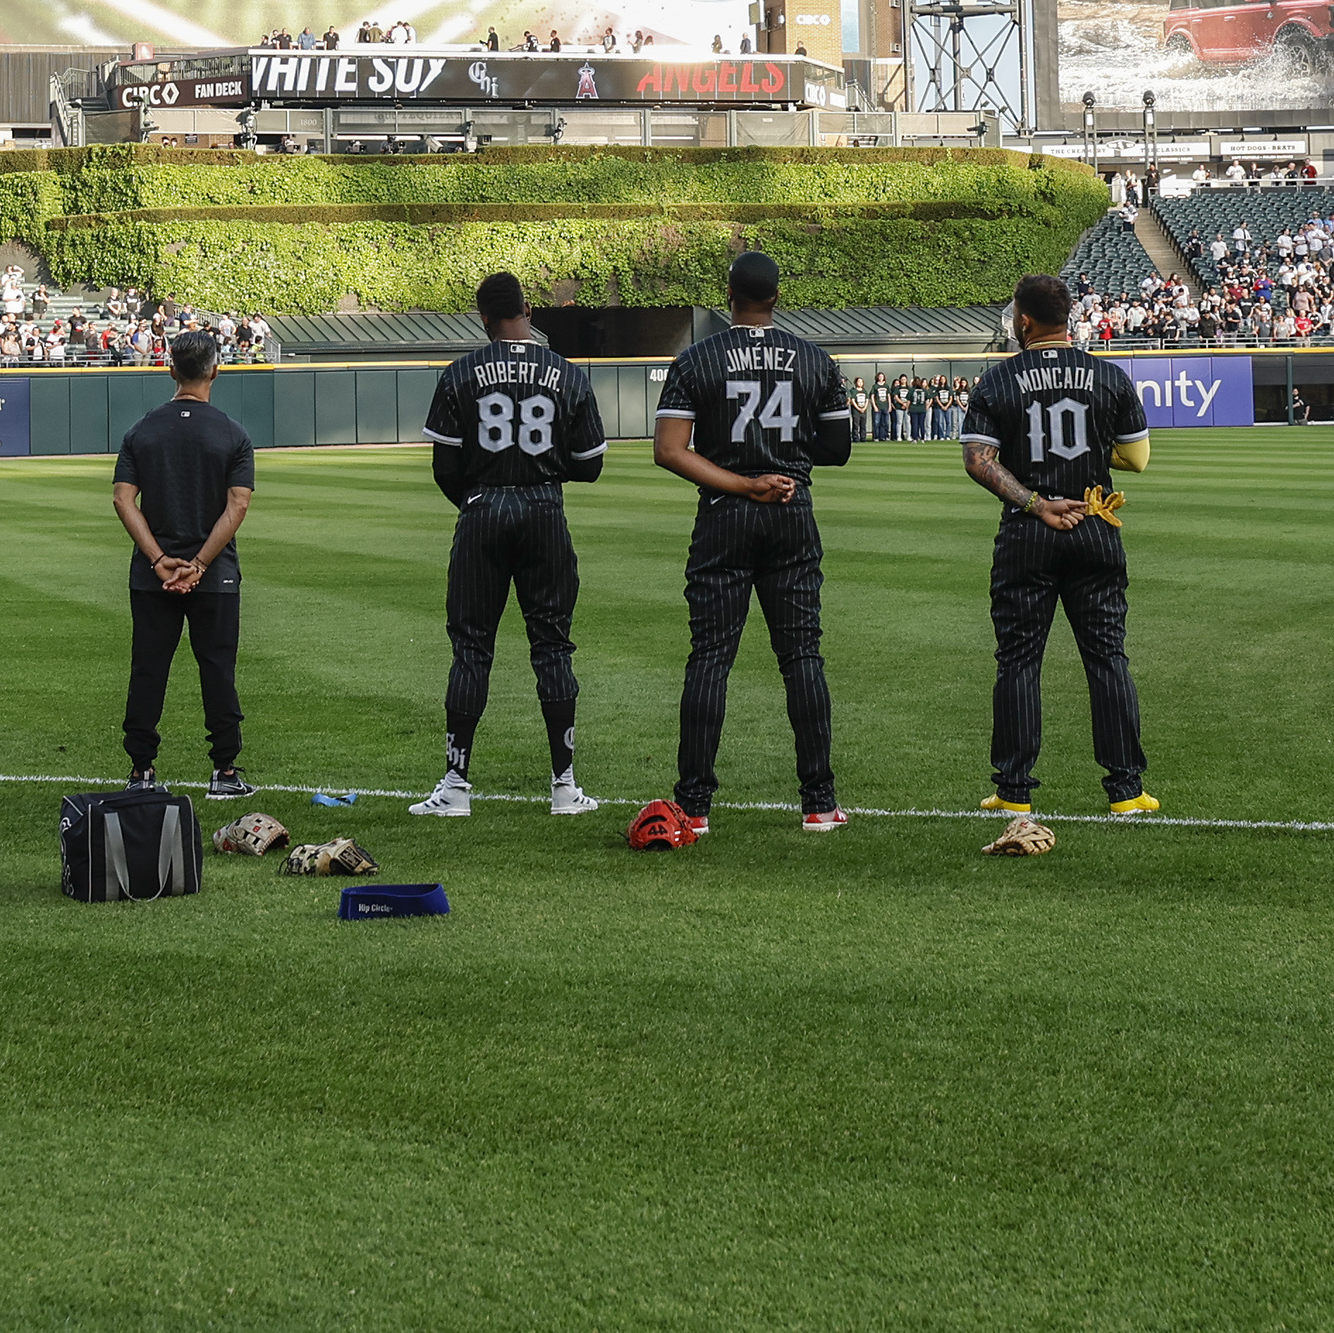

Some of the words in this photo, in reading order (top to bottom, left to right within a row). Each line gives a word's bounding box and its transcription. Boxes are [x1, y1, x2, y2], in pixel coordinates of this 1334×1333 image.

[195, 82, 215, 99] FAN
[215, 80, 243, 97] DECK
[636, 61, 786, 93] ANGELS
[300, 118, 317, 126] 1800
[726, 342, 796, 373] JIMÉNEZ
[473, 361, 539, 389] ROBERT
[538, 366, 562, 393] JR.
[1013, 366, 1095, 395] MONCADA
[1136, 370, 1222, 417] nity
[476, 391, 557, 457] 88
[725, 380, 800, 443] 74
[1024, 396, 1092, 463] 10
[358, 903, 370, 913] Hip
